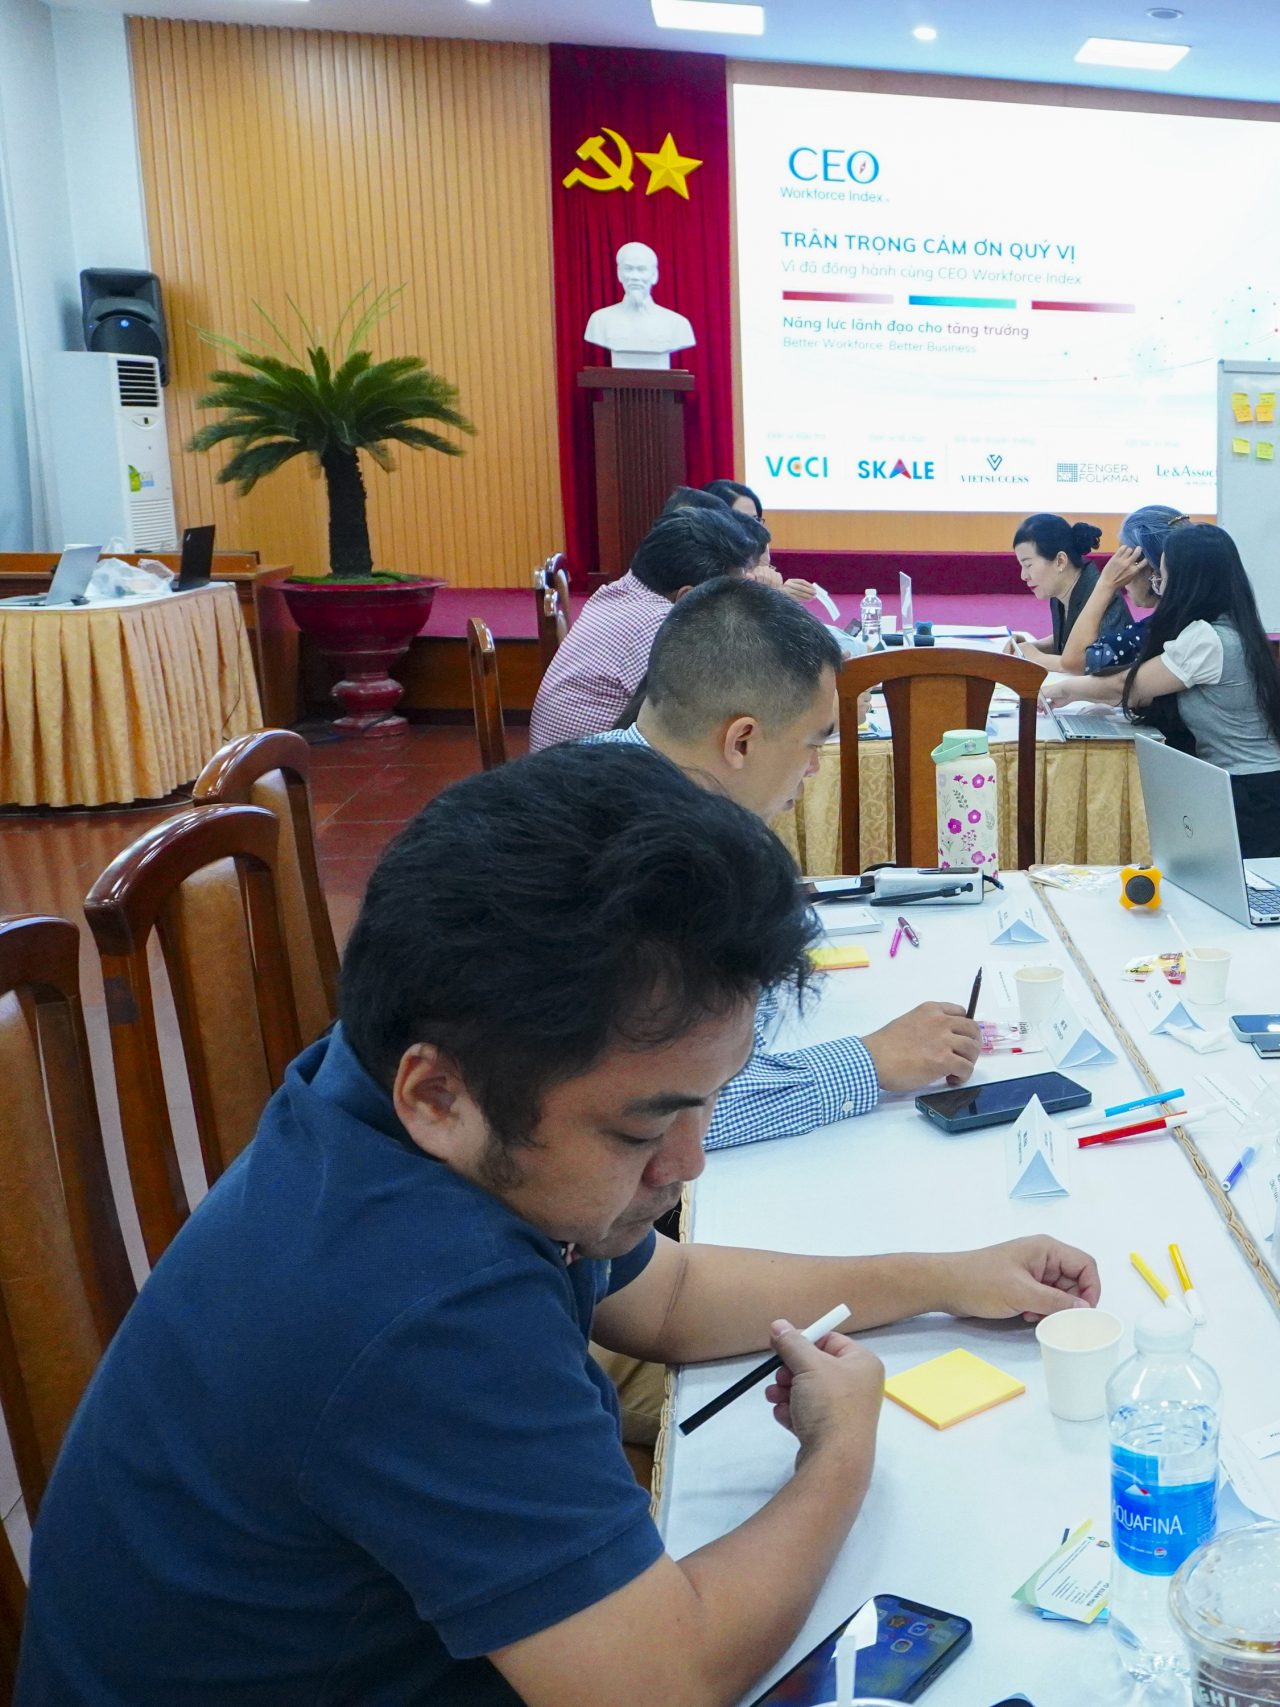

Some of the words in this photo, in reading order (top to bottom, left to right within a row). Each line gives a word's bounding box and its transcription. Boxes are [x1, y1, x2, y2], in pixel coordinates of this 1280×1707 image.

[788, 147, 880, 184] CEO
[780, 186, 845, 201] Workforce
[849, 190, 883, 203] Index
[781, 228, 837, 249] TRÂN
[845, 235, 916, 255] TRỌNG
[974, 239, 1002, 256] ƠN
[1010, 240, 1050, 261] QUÝ
[1056, 244, 1075, 264] VỊ
[938, 266, 967, 279] CEO
[973, 268, 1041, 284] Workforce
[1046, 272, 1081, 285] Index
[918, 321, 942, 333] cho
[765, 455, 828, 478] VCCI
[857, 458, 935, 479] SKALE
[1079, 464, 1129, 473] ZENGER
[1079, 473, 1138, 483] FOLKMAN
